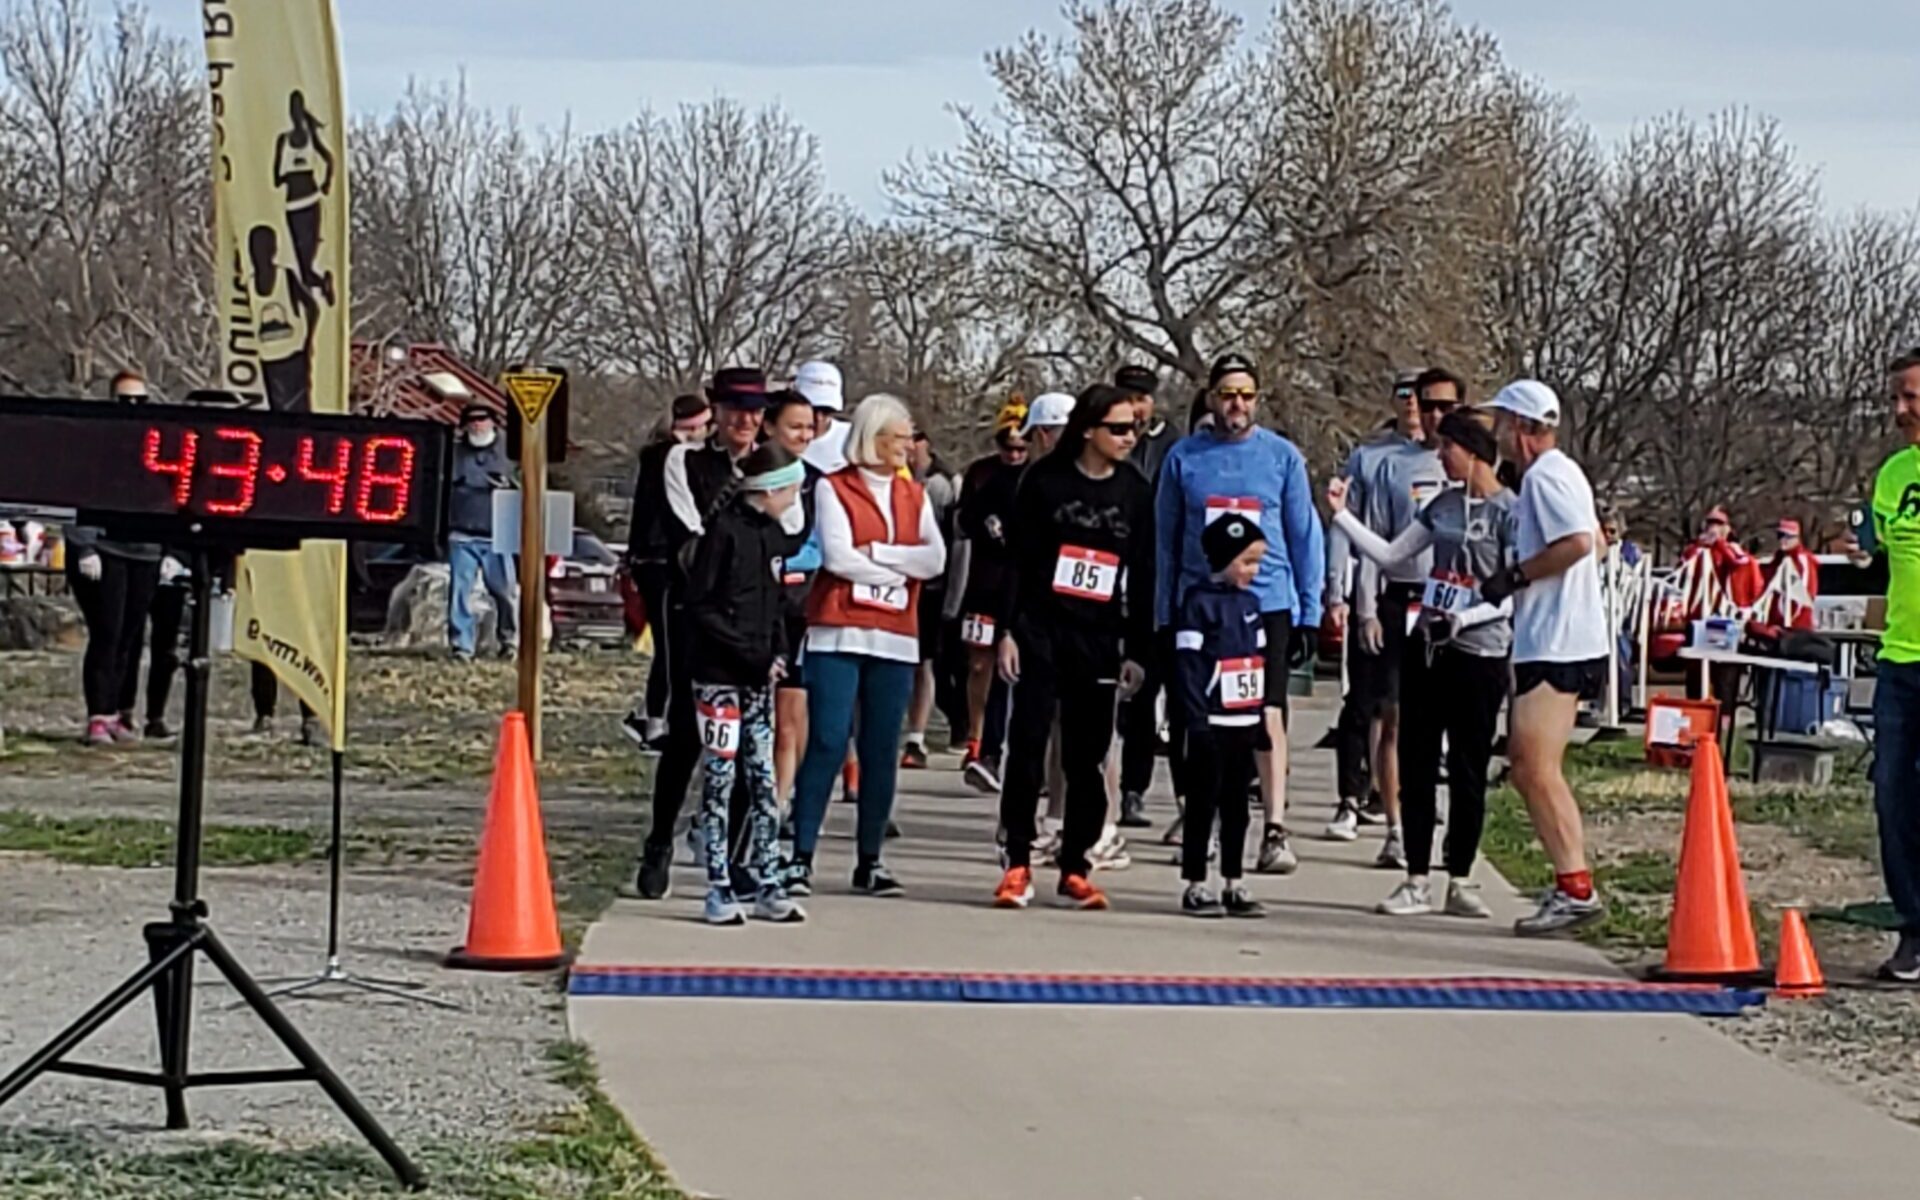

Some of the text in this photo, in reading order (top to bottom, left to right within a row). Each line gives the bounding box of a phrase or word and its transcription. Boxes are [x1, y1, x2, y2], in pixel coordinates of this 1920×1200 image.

[1072, 561, 1100, 590] 85
[1237, 672, 1257, 698] 59
[704, 719, 732, 749] 66
